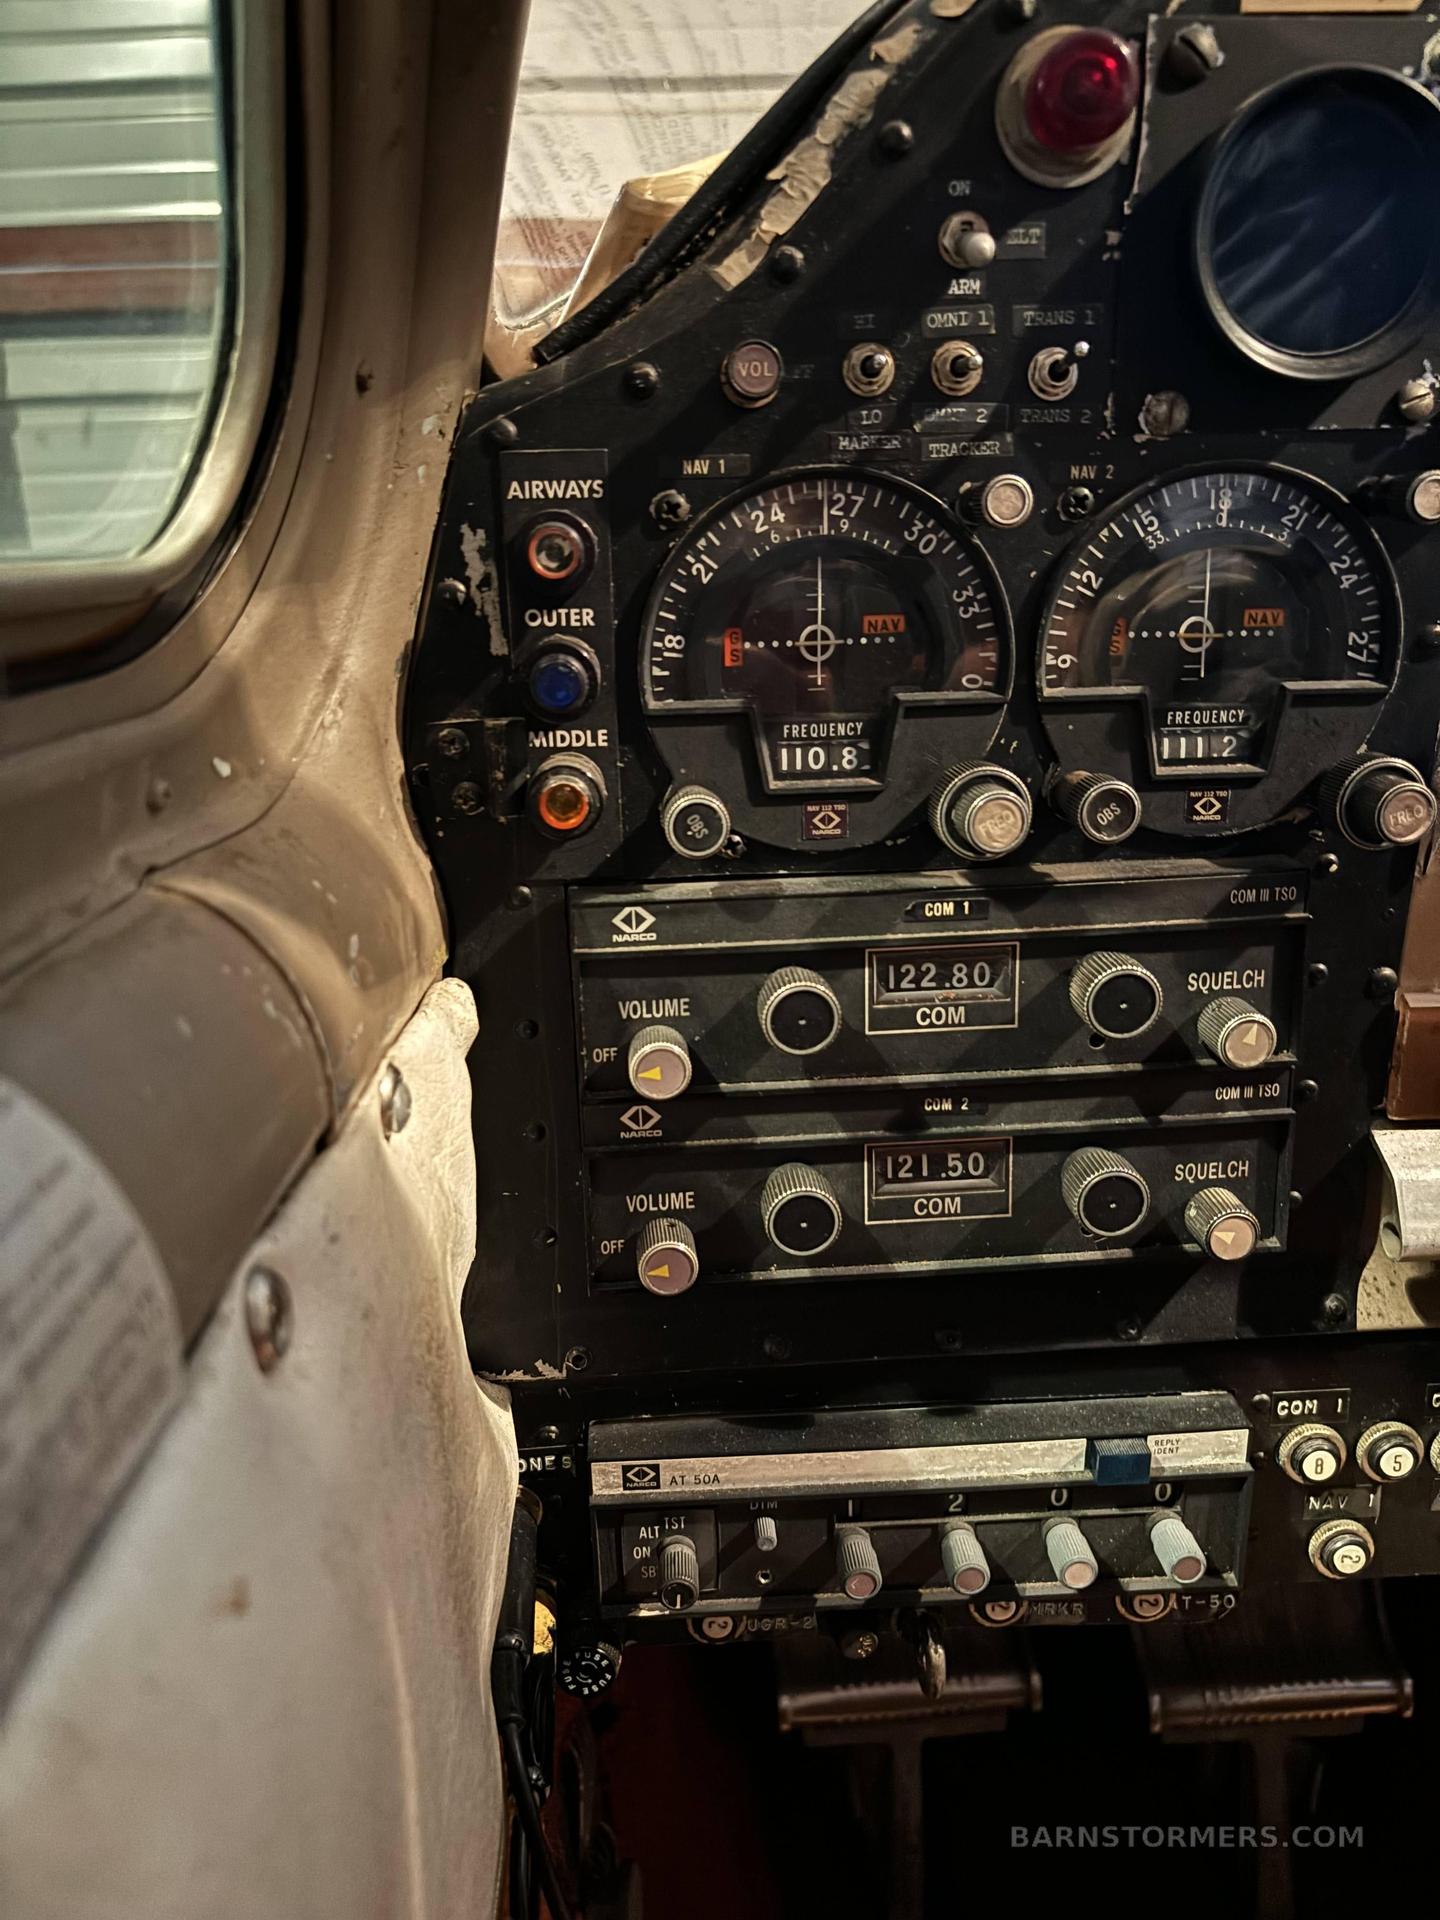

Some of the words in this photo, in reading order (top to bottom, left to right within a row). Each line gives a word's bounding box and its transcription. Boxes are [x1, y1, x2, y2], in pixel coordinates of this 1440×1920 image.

[949, 180, 970, 196] ON
[948, 278, 981, 295] ARM
[927, 312, 969, 329] OMNI
[978, 312, 990, 327] 1
[1024, 309, 1074, 326] TRANS
[1085, 310, 1096, 325] 1
[737, 362, 774, 377] VOL
[861, 410, 882, 425] LO
[976, 408, 988, 424] 2
[1021, 408, 1070, 424] TRANS
[1081, 409, 1092, 424] 2
[839, 433, 902, 450] MARKER
[929, 440, 1000, 458] TRACKER
[683, 459, 710, 475] NAV
[718, 459, 726, 474] 1
[1070, 465, 1097, 480] NAV
[1105, 464, 1115, 479] 2
[506, 479, 605, 500] AIRWAYS
[770, 530, 781, 544] 6
[839, 519, 850, 533] 9
[663, 634, 686, 658] 18
[691, 553, 719, 584] 21
[751, 502, 787, 534] 24
[829, 493, 864, 518] 27
[904, 519, 938, 554] 30
[953, 588, 980, 620] 33
[1076, 569, 1103, 597] 12
[1132, 508, 1159, 537] 15
[1210, 487, 1233, 511] 18
[1280, 505, 1310, 530] 21
[1329, 555, 1355, 589] 24
[1346, 631, 1370, 663] 27
[524, 608, 597, 628] OUTER
[867, 618, 902, 633] NAV
[1246, 610, 1282, 625] NAV
[1167, 708, 1245, 725] FREQUENCY
[528, 729, 609, 748] MIDDLE
[783, 721, 864, 739] FREQUENCY
[1162, 735, 1238, 759] 111.2
[780, 746, 859, 772] 110.8
[1096, 802, 1122, 827] OBS
[686, 814, 710, 840] OBS
[812, 828, 842, 836] NARCO
[1230, 888, 1257, 905] COM
[1274, 886, 1298, 902] TSO
[924, 901, 956, 918] COM
[963, 901, 970, 916] 1
[612, 932, 658, 943] NARCO
[888, 961, 991, 990] 122.80
[1187, 968, 1266, 992] SQUELCH
[618, 998, 691, 1020] VOLUME
[915, 1005, 966, 1027] COM
[593, 1047, 618, 1063] OFF
[1214, 1084, 1241, 1101] COM
[1258, 1082, 1281, 1099] TSO
[924, 1097, 953, 1112] COM
[960, 1097, 970, 1111] 2
[620, 1129, 663, 1139] NARCO
[886, 1151, 986, 1180] 121.50
[1173, 1159, 1249, 1183] SQUELCH
[626, 1191, 696, 1213] VOLUME
[913, 1196, 962, 1217] COM
[600, 1239, 625, 1255] OFF
[1277, 1399, 1318, 1416] COM
[1336, 1398, 1343, 1413] 1
[1153, 1446, 1180, 1455] IDENT
[1154, 1438, 1181, 1447] REPLY
[1314, 1457, 1324, 1475] 8
[1392, 1454, 1403, 1472] 5
[669, 1474, 687, 1487] AT
[693, 1473, 720, 1486] 50A
[848, 1499, 854, 1517] 1
[949, 1494, 964, 1513] 2
[1051, 1488, 1069, 1507] 0
[1155, 1482, 1173, 1502] 0
[1308, 1496, 1350, 1511] NAV
[1367, 1493, 1376, 1508] 1
[664, 1516, 686, 1531] TST
[639, 1525, 660, 1540] ALT
[633, 1546, 651, 1560] ON
[641, 1566, 658, 1579] SB
[1030, 1602, 1084, 1617] MRKR
[574, 1651, 610, 1668] FUSE
[582, 1673, 613, 1696] FUSE
